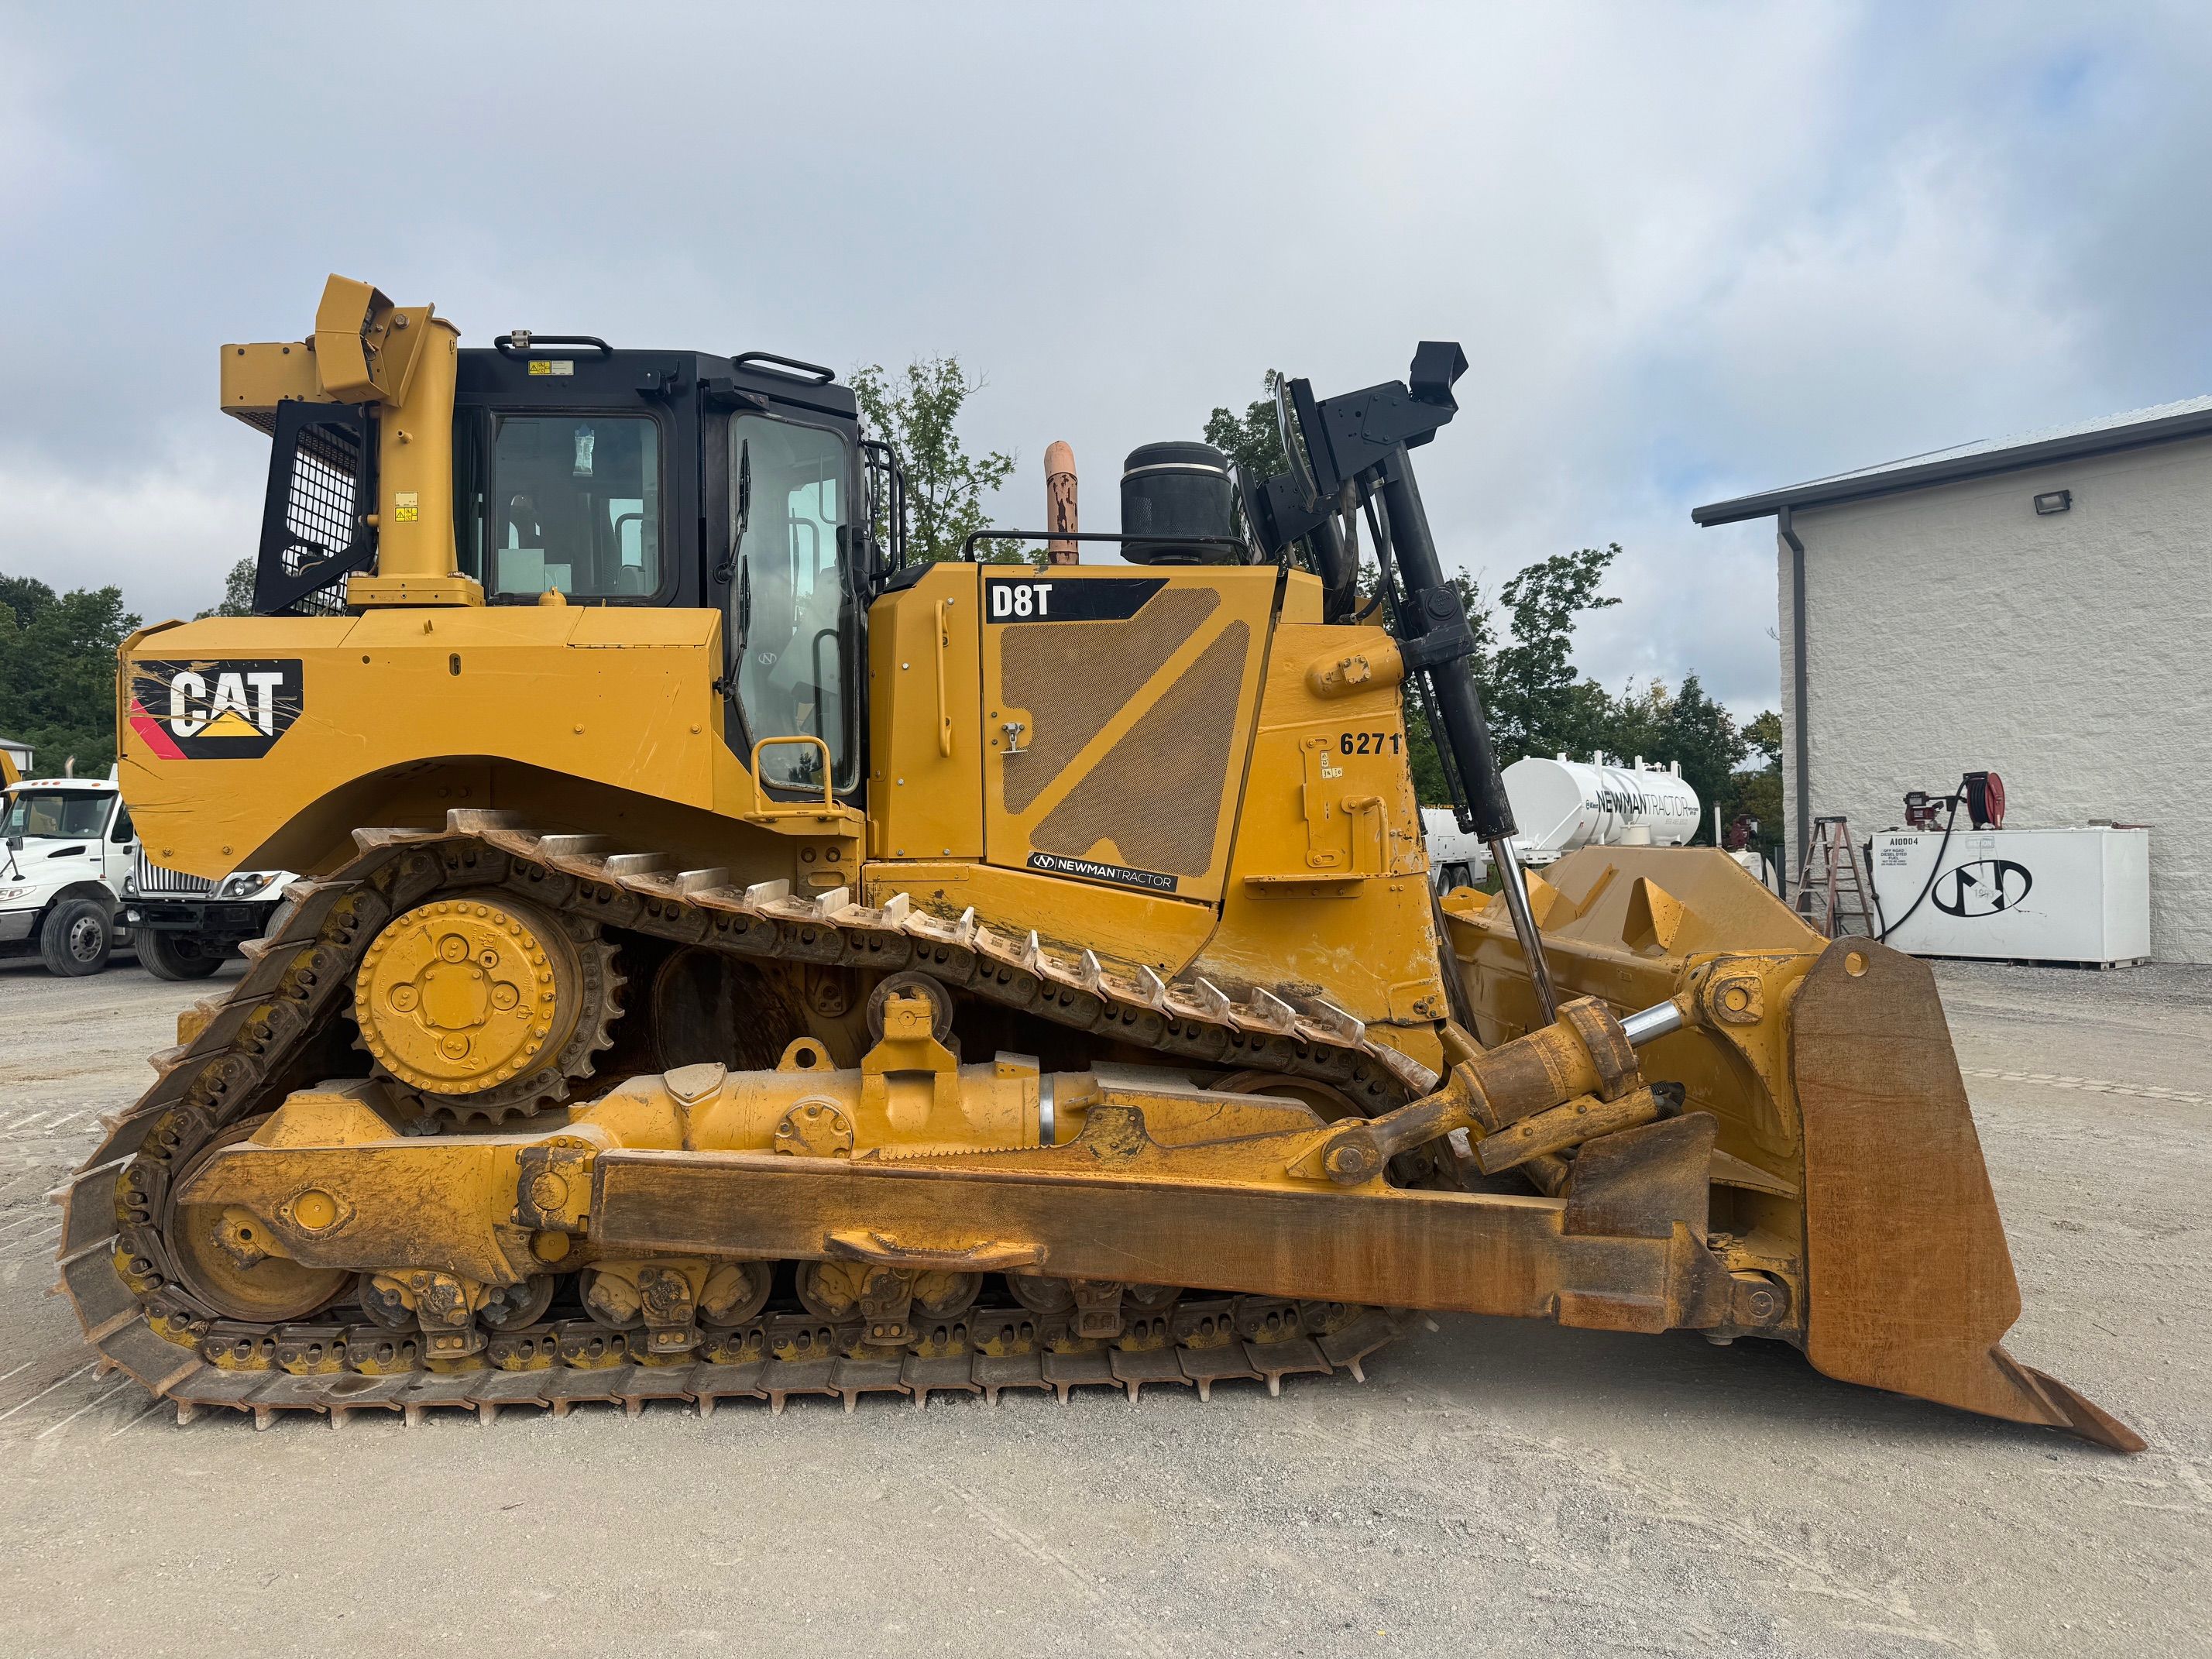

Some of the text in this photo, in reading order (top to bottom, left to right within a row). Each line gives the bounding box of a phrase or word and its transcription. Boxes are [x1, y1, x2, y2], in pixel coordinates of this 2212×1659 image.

[992, 584, 1053, 617] D8T
[170, 672, 283, 737] CAT
[1340, 733, 1399, 755] 6271
[1058, 859, 1171, 888] NEWMANTRACTOR
